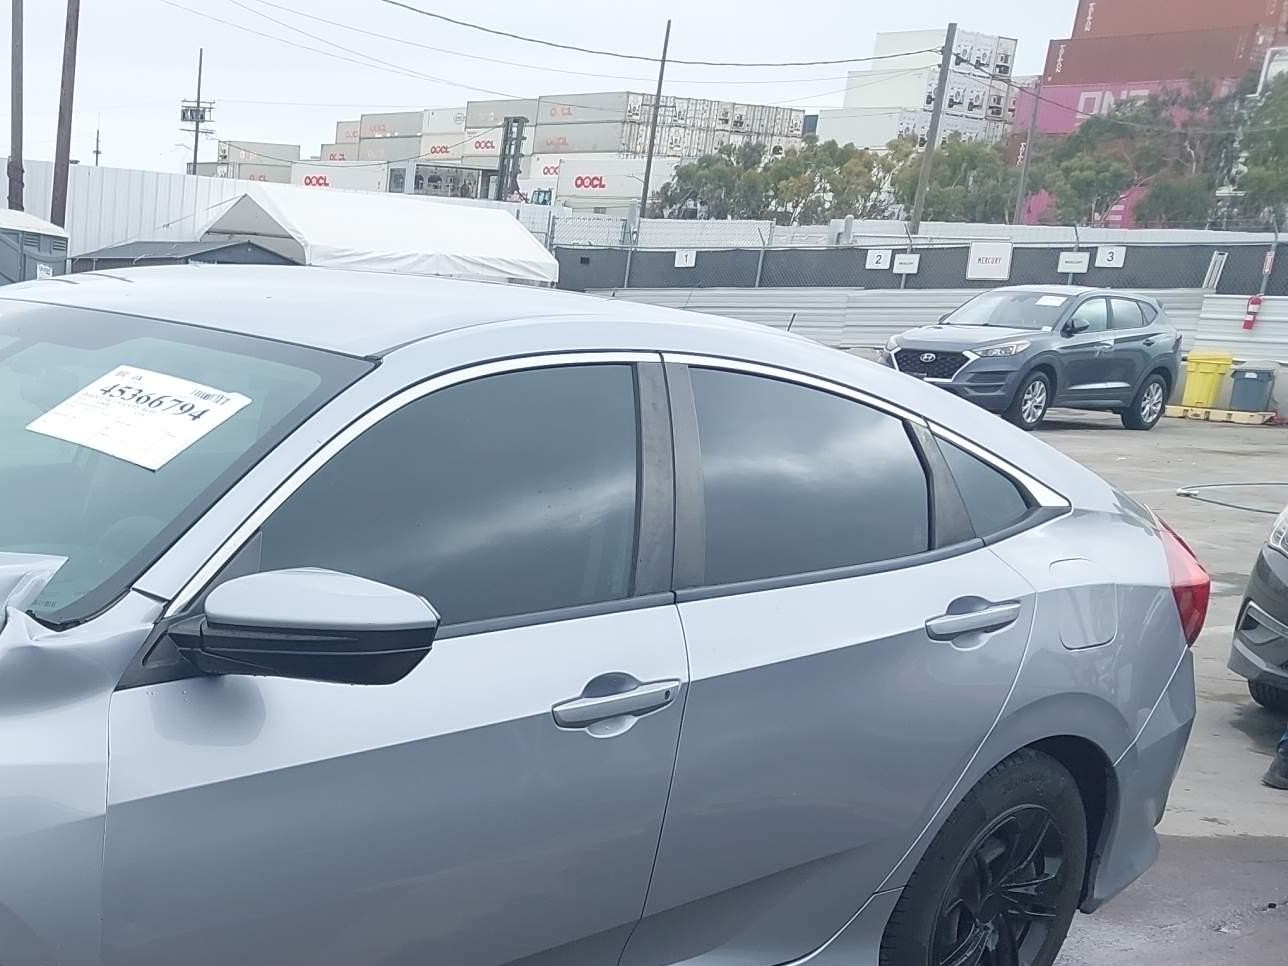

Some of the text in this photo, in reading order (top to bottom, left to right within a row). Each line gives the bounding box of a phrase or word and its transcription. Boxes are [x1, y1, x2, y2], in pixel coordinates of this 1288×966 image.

[1075, 89, 1150, 119] ON
[430, 145, 450, 154] OOCL
[474, 140, 496, 149] OOCL
[543, 166, 560, 175] OOC
[304, 175, 330, 187] OOCL
[575, 176, 606, 188] OOCL
[684, 254, 689, 264] 1
[874, 254, 882, 265] 2
[977, 256, 1002, 265] MERCURY
[1106, 251, 1115, 262] 3
[100, 383, 210, 421] 45366794
